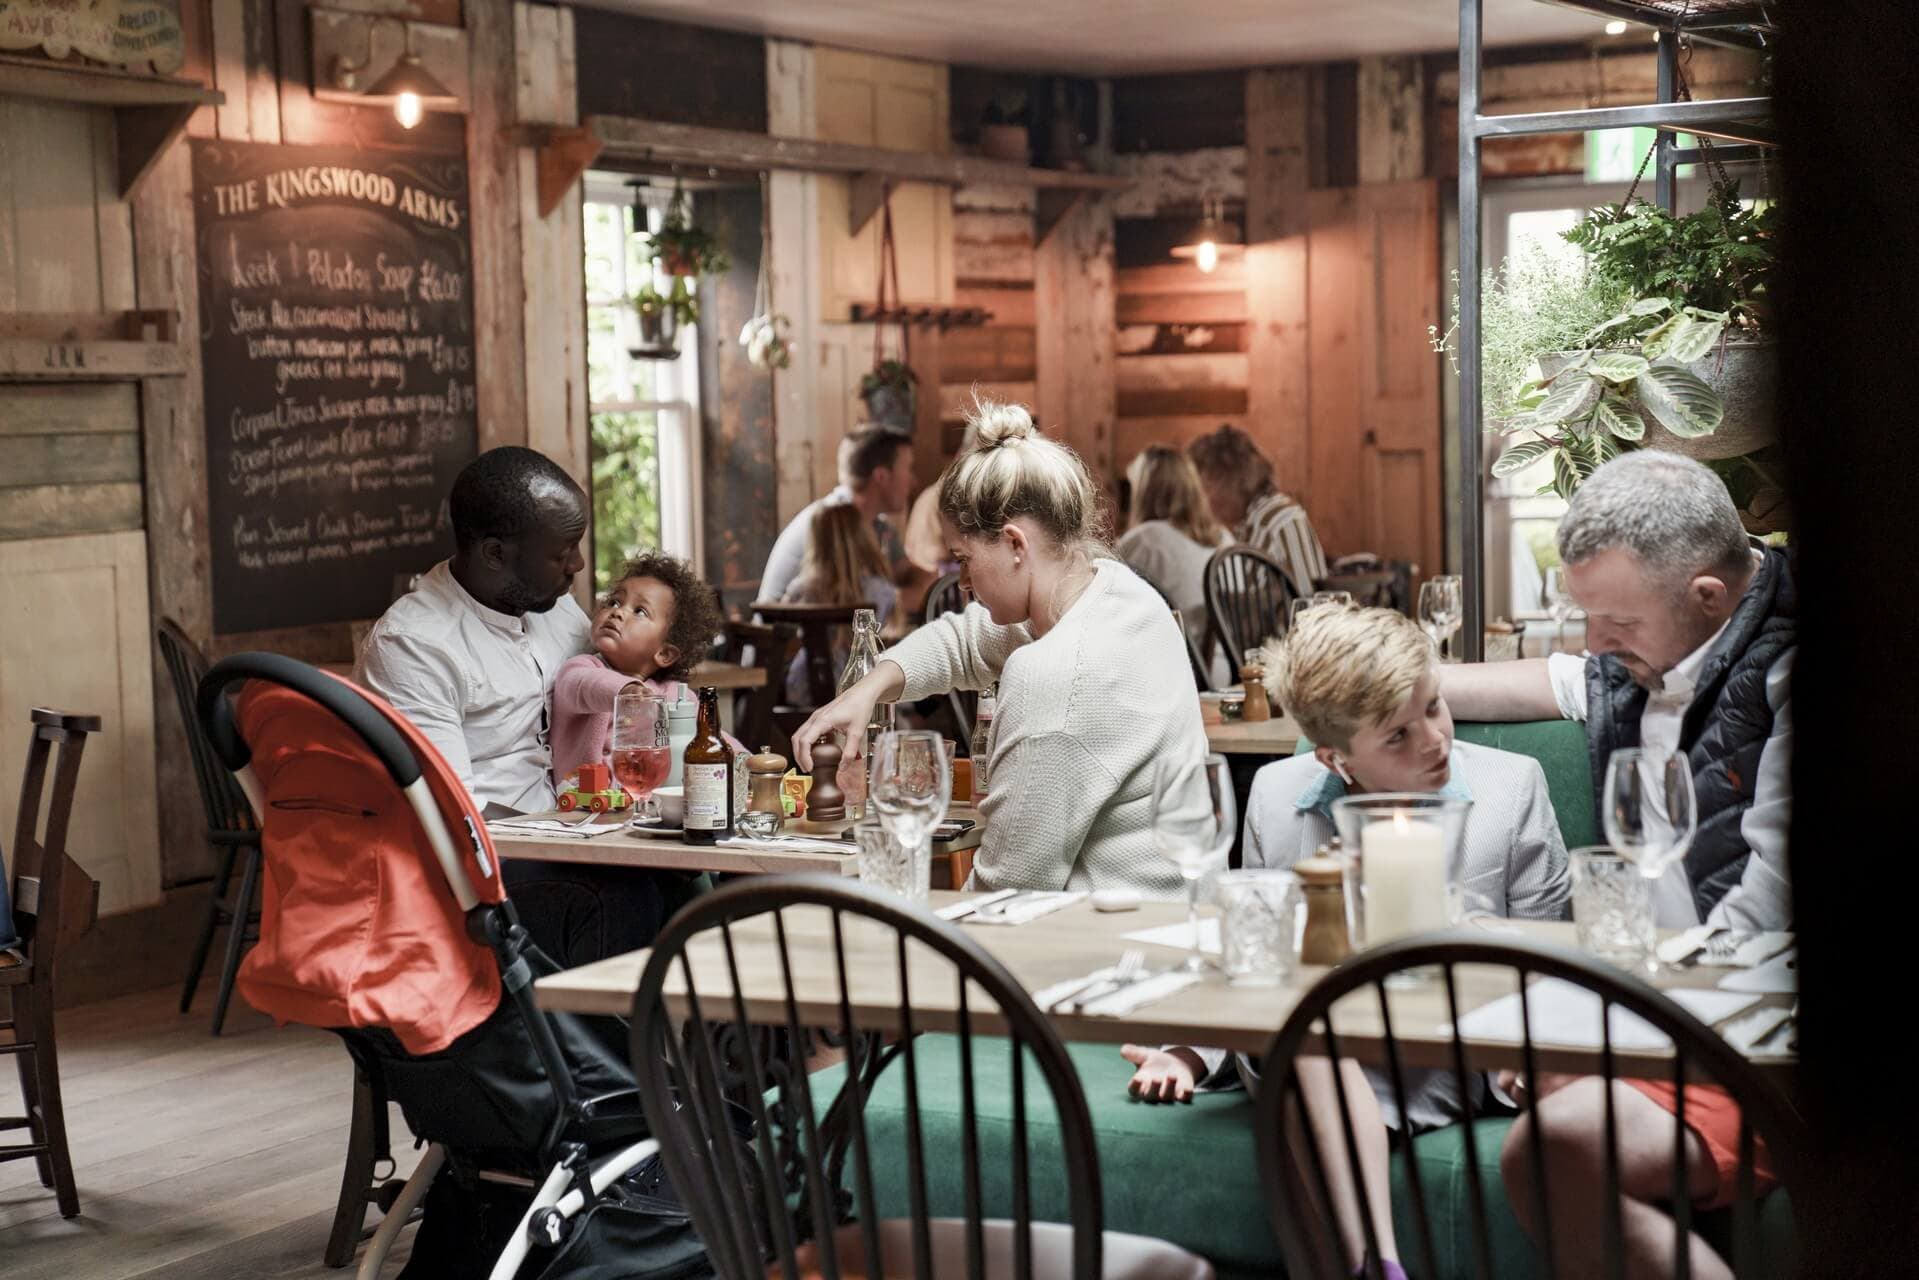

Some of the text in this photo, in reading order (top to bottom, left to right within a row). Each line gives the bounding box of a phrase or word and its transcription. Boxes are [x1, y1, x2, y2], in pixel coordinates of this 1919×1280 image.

[214, 166, 460, 229] THE KINGSWOOD ARMS
[229, 231, 281, 289] Leek
